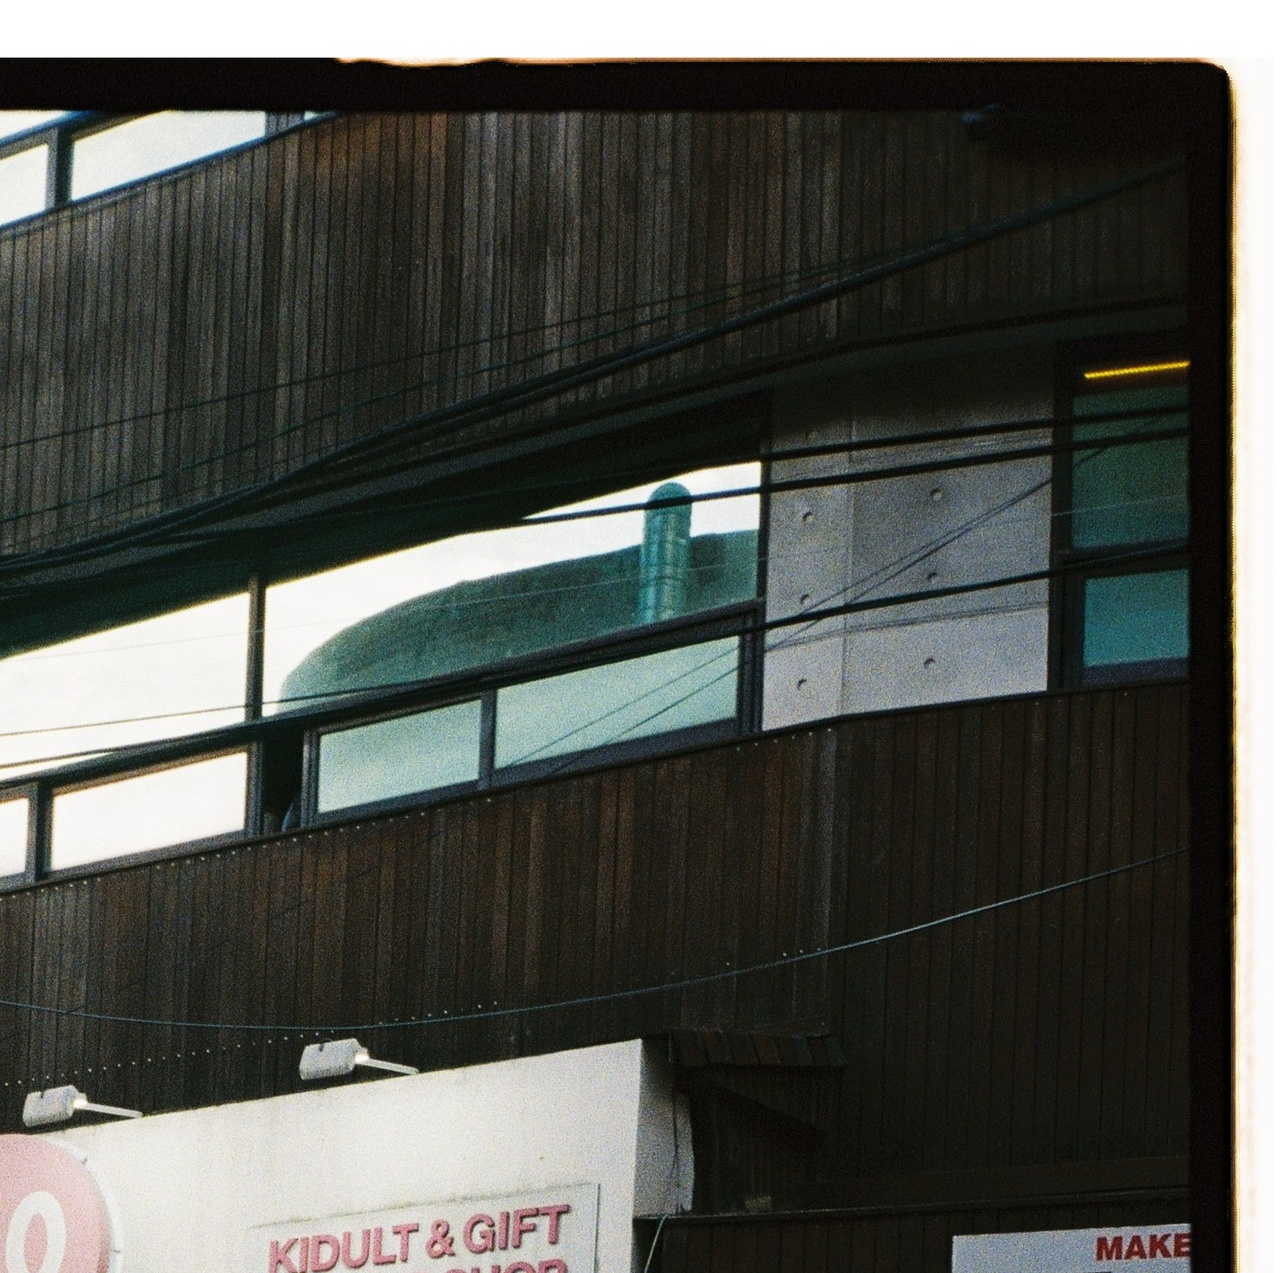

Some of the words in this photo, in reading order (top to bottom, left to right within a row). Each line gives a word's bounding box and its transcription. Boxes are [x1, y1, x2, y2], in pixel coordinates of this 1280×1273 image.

[425, 1219, 455, 1259] &
[463, 1204, 570, 1254] GIFT
[1096, 1232, 1191, 1261] MAKE
